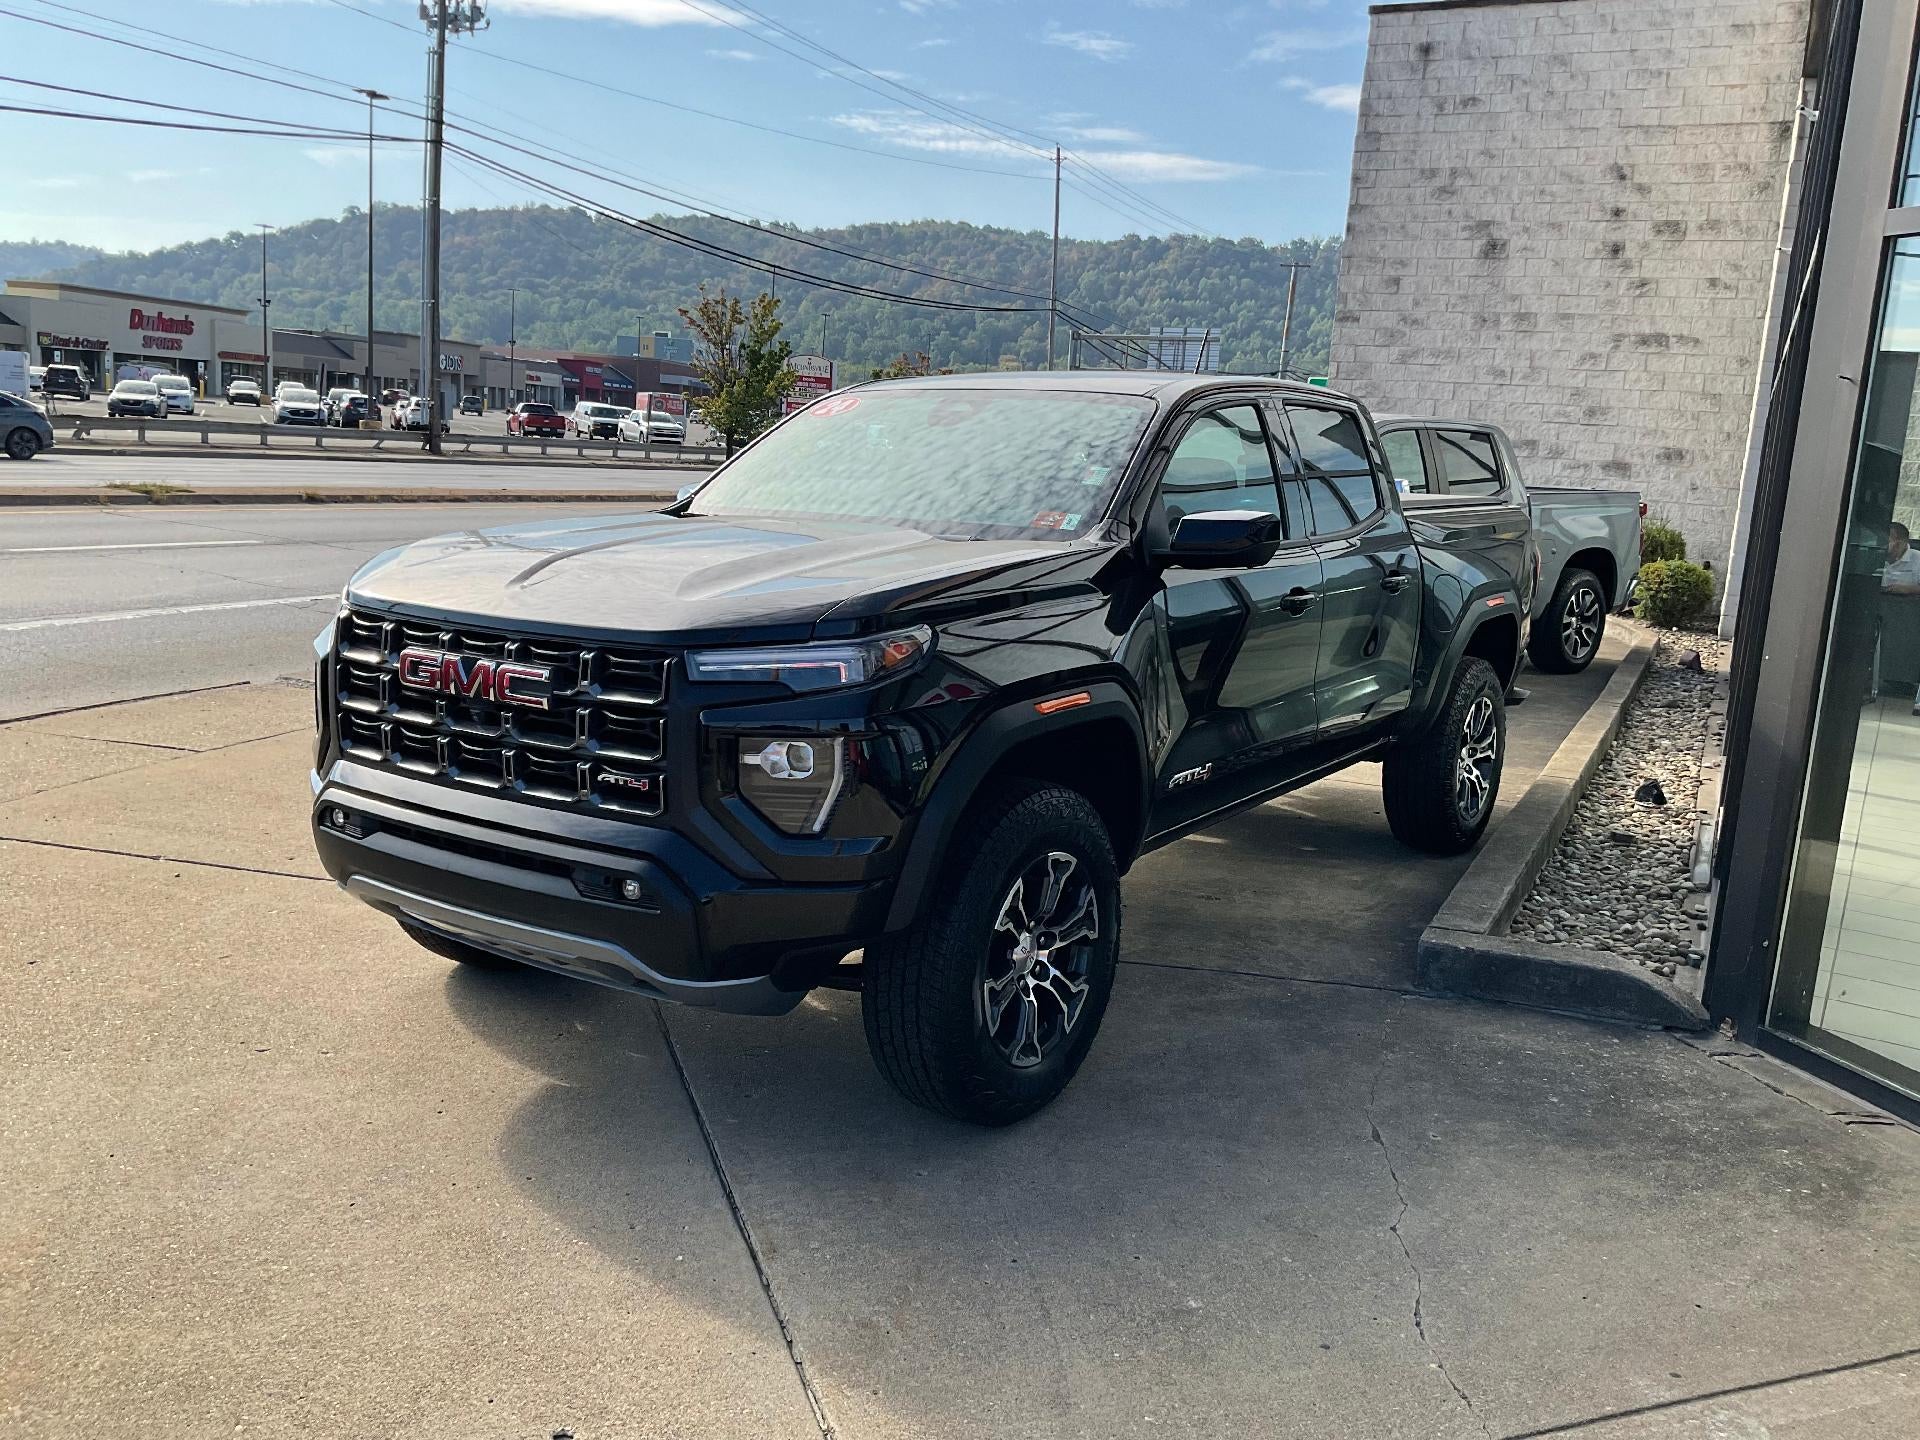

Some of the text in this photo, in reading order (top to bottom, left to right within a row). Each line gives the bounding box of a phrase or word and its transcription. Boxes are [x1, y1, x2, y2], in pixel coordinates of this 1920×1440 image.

[130, 308, 194, 335] Dunham's
[142, 334, 183, 351] SPORTS
[398, 646, 550, 710] GMC
[597, 772, 649, 792] AT4
[1168, 762, 1212, 789] AT4
